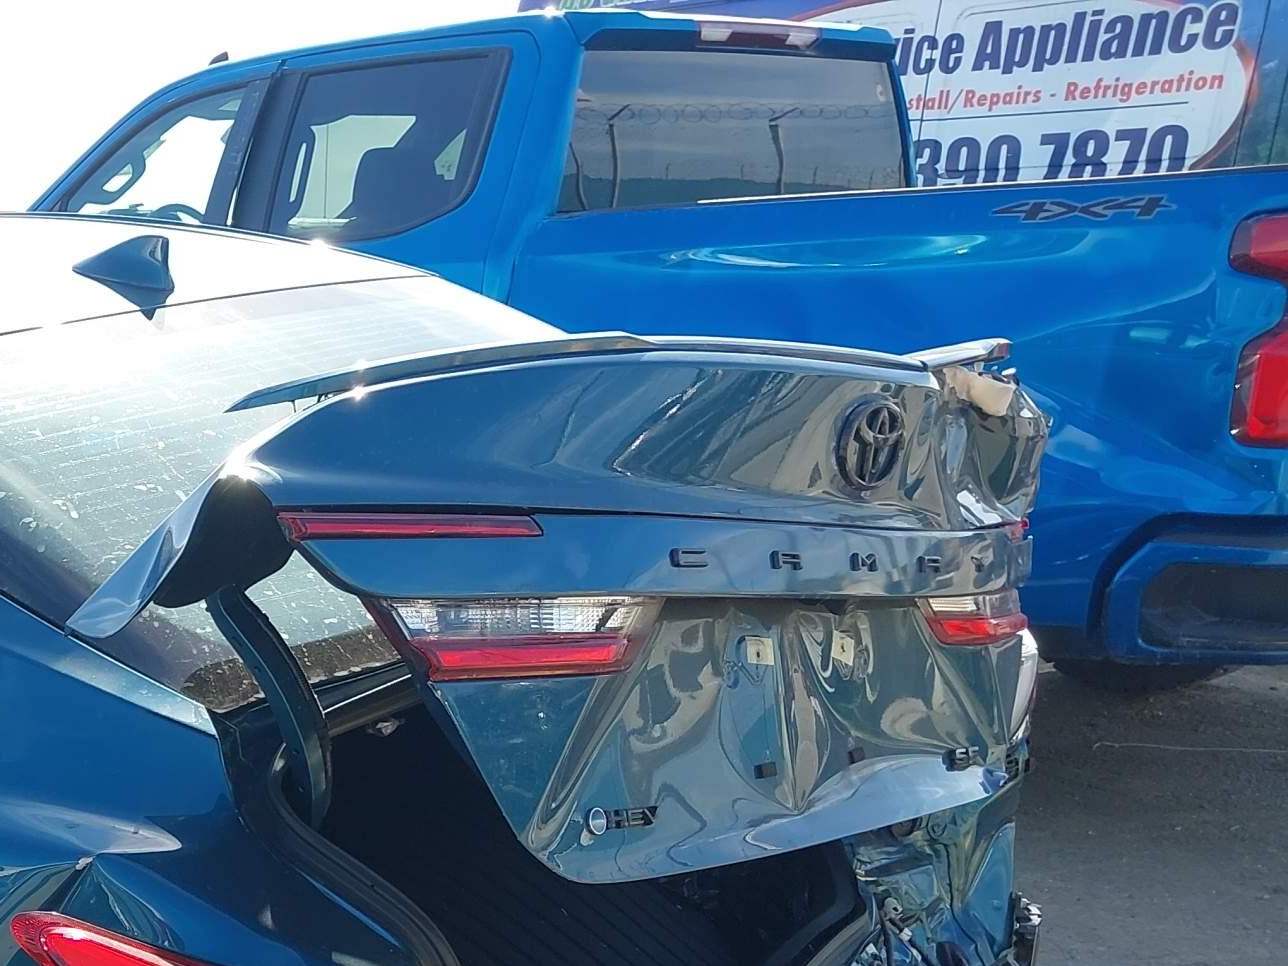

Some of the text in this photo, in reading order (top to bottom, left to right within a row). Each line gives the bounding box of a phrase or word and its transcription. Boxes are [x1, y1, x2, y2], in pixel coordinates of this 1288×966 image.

[971, 2, 1239, 75] Appliance
[1064, 70, 1225, 104] Refrigeration
[913, 124, 1190, 188] 390 7870
